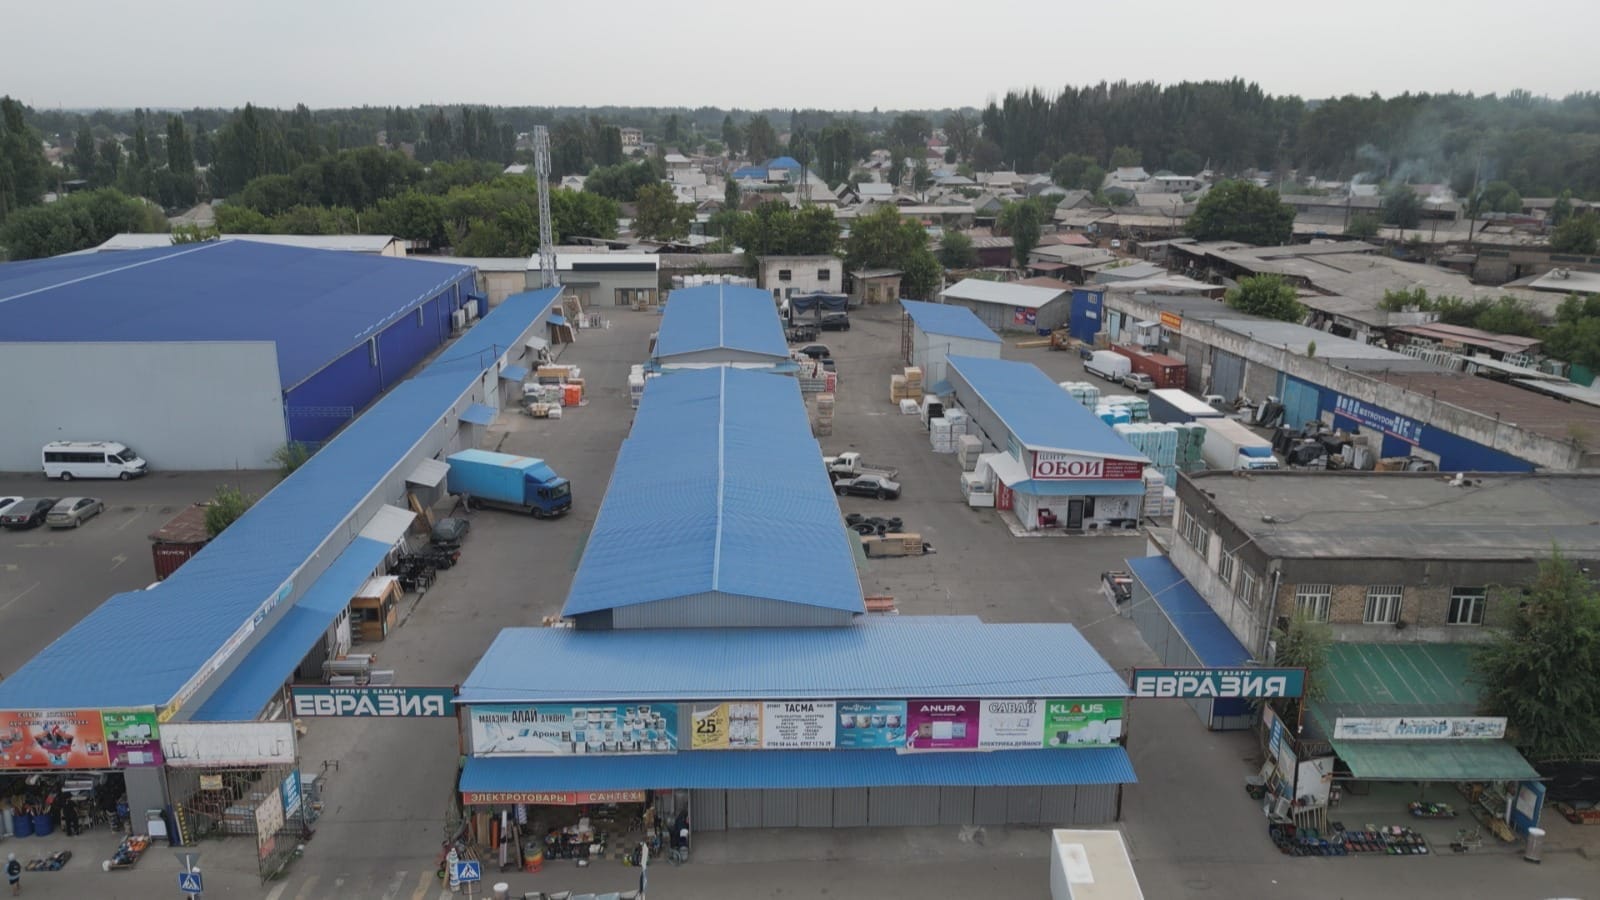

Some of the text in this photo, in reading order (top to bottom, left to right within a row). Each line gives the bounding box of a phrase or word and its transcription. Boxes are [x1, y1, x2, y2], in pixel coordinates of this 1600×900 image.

[1038, 461, 1101, 476] ОБОИ
[1136, 676, 1287, 697] ЕВРАЗИЯ
[294, 695, 445, 716] ЕВРАЗИЯ
[784, 703, 815, 713] ТАСМА
[920, 704, 966, 713] ANURA
[1050, 704, 1104, 713] KLAUS
[478, 714, 509, 723] МАГАЗИН
[512, 707, 538, 723] АЛАЙ
[471, 793, 568, 802] ЭЛЕКТРОТОВАРЫ
